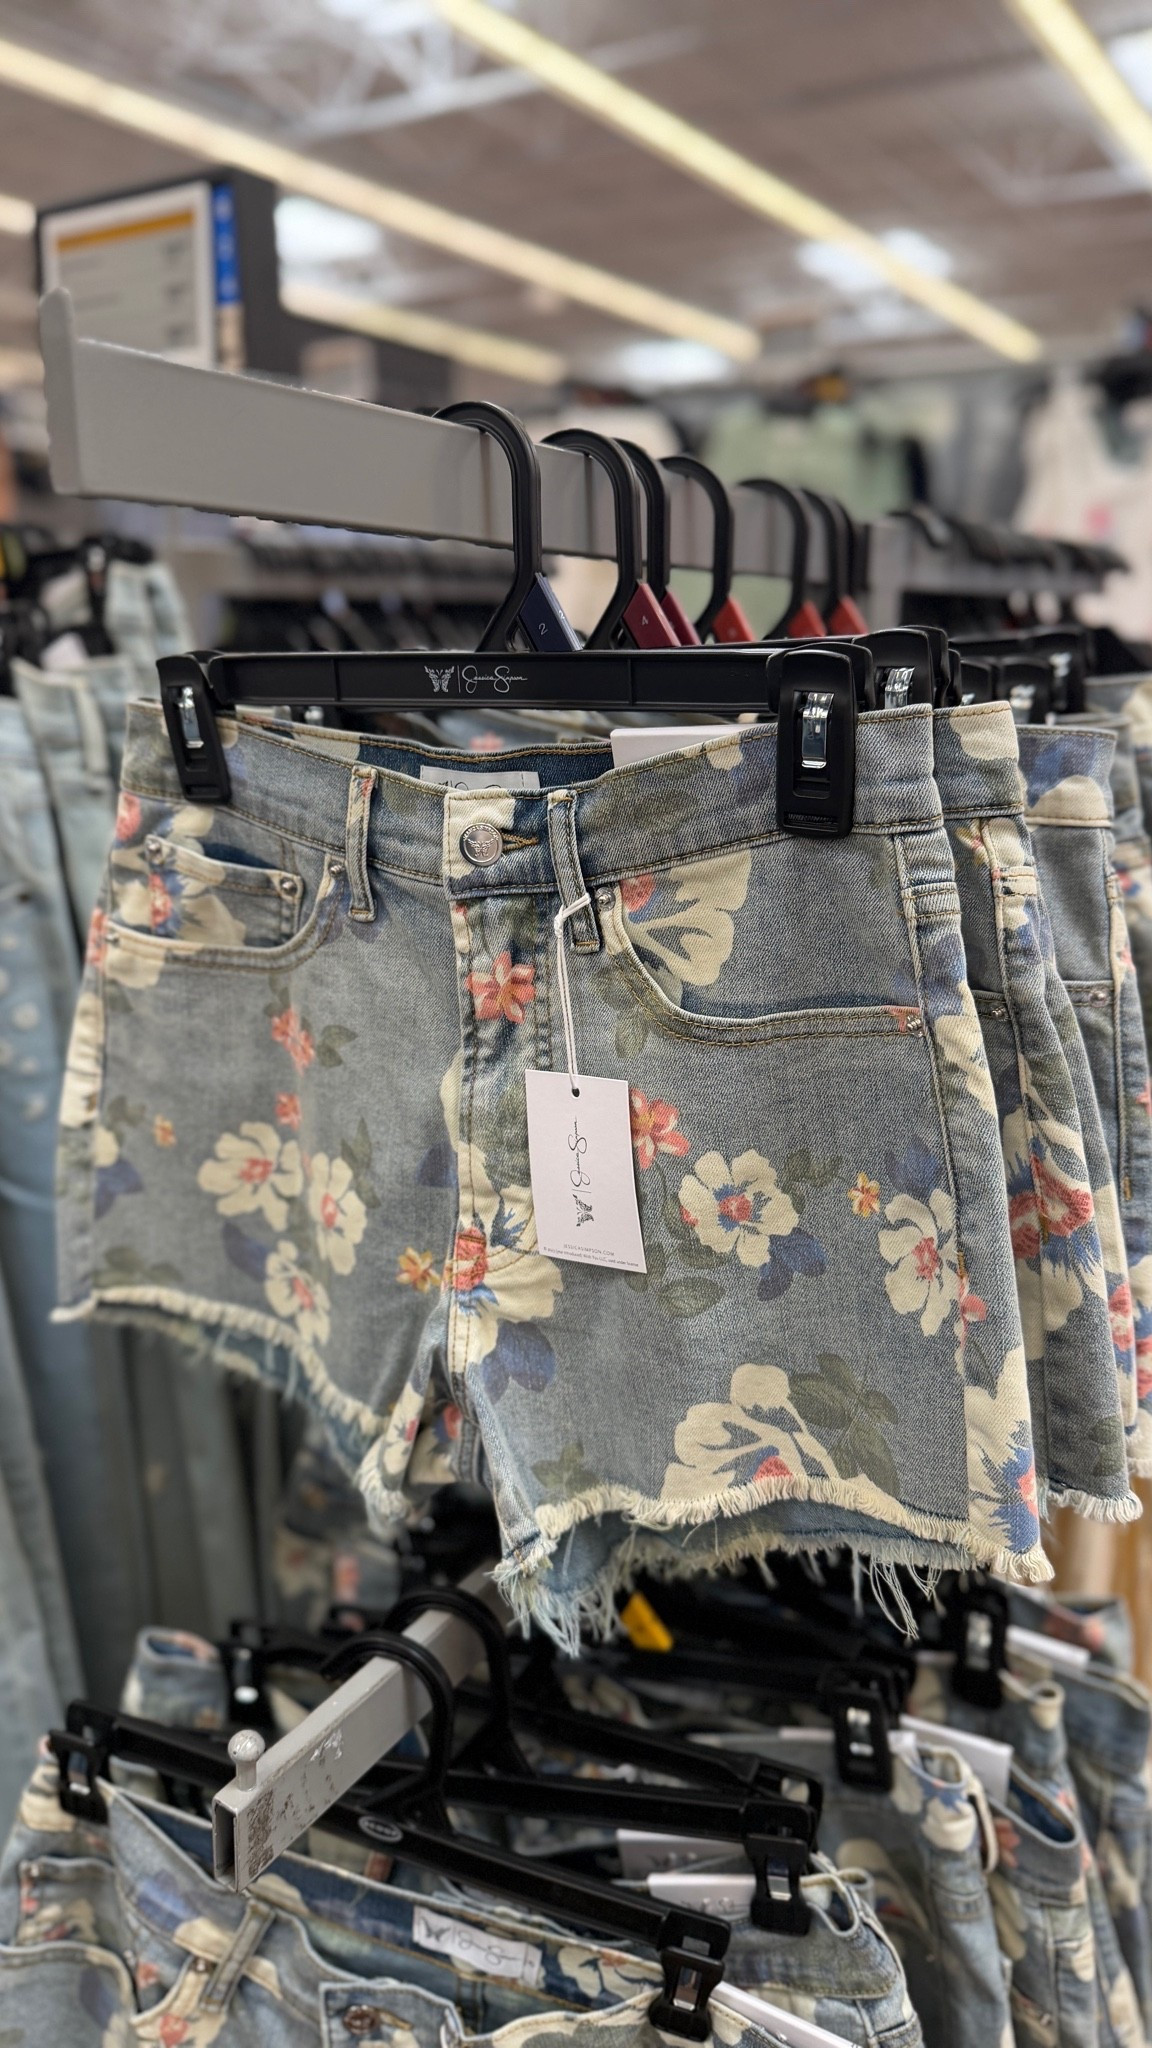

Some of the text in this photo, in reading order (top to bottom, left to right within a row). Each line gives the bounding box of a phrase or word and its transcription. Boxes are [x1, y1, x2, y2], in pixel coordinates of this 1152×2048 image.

[538, 622, 549, 635] 2
[461, 665, 528, 693] Jessica Simpson
[567, 1115, 591, 1188] Jessica Simpson
